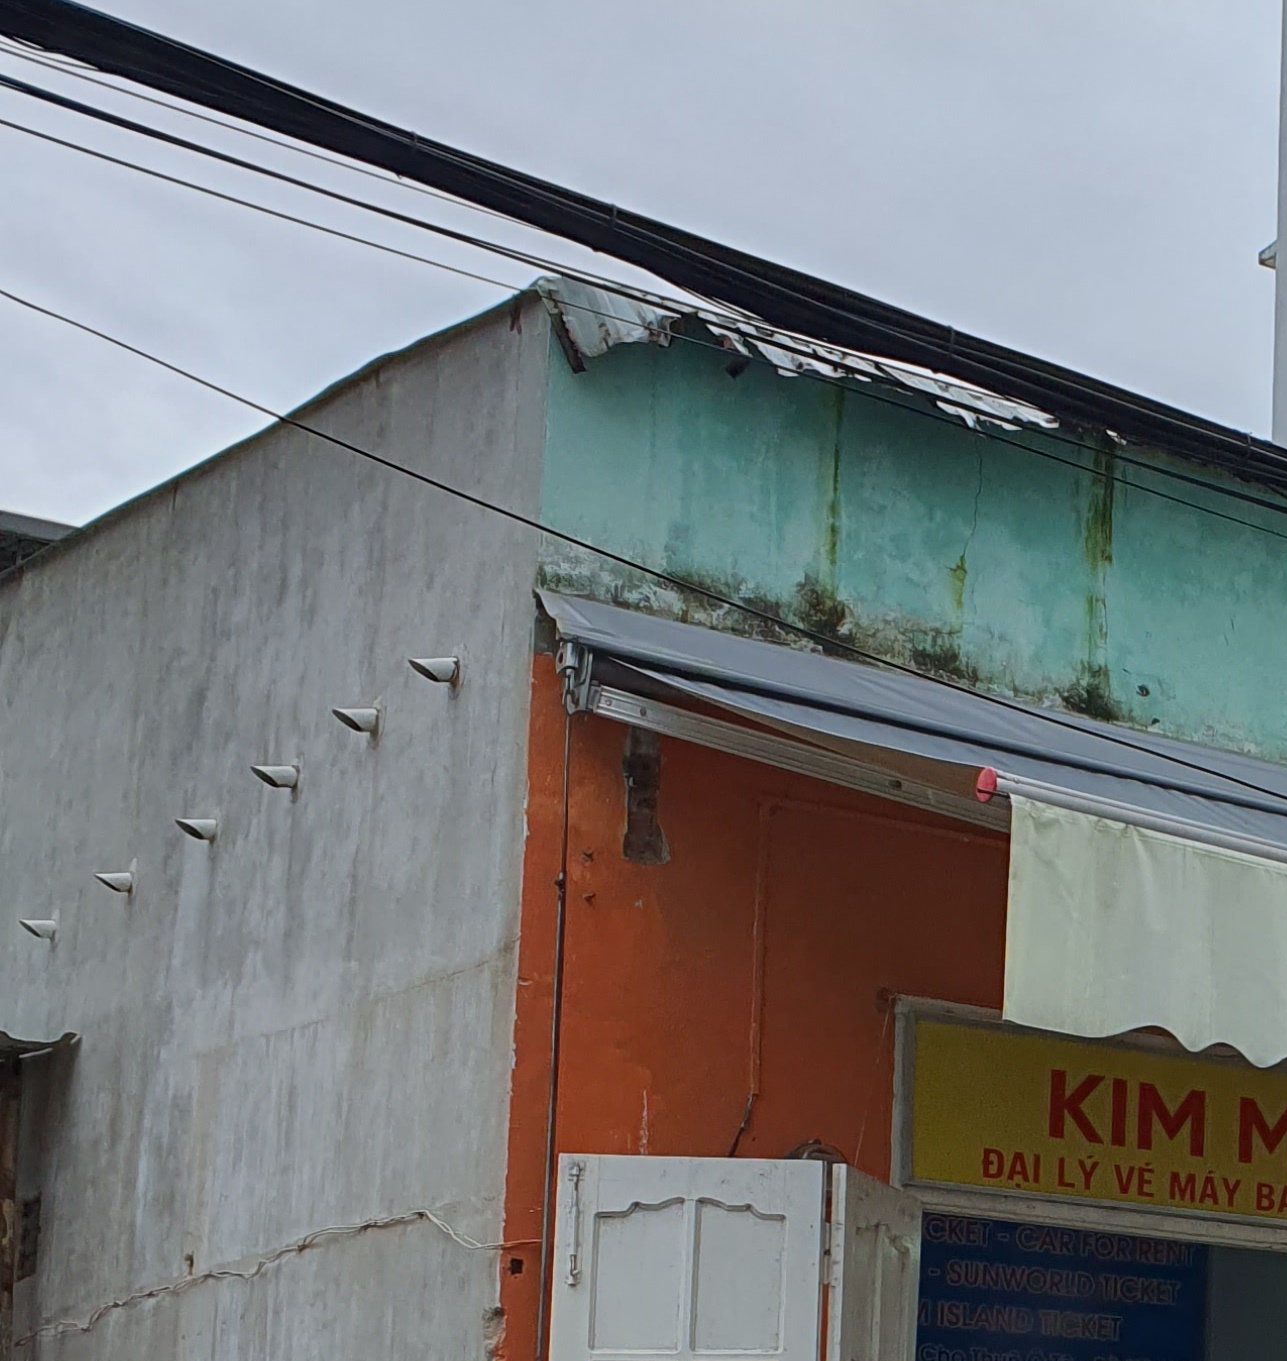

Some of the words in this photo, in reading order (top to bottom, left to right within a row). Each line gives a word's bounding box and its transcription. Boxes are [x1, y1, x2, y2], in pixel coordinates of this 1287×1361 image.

[1048, 1068, 1207, 1158] KIM
[981, 1147, 1041, 1188] ĐẠI
[1055, 1154, 1100, 1191] LÝ
[1113, 1160, 1155, 1198] VÉ
[1168, 1169, 1242, 1208] MÁY
[1016, 1225, 1075, 1256] CAR
[1080, 1231, 1132, 1262] FOR
[1136, 1237, 1197, 1267] RENT
[947, 1259, 1096, 1298] SUNWORLD
[1100, 1273, 1183, 1306] TICKET
[937, 1300, 1035, 1334] ISLAND
[1039, 1311, 1124, 1343] TICKET
